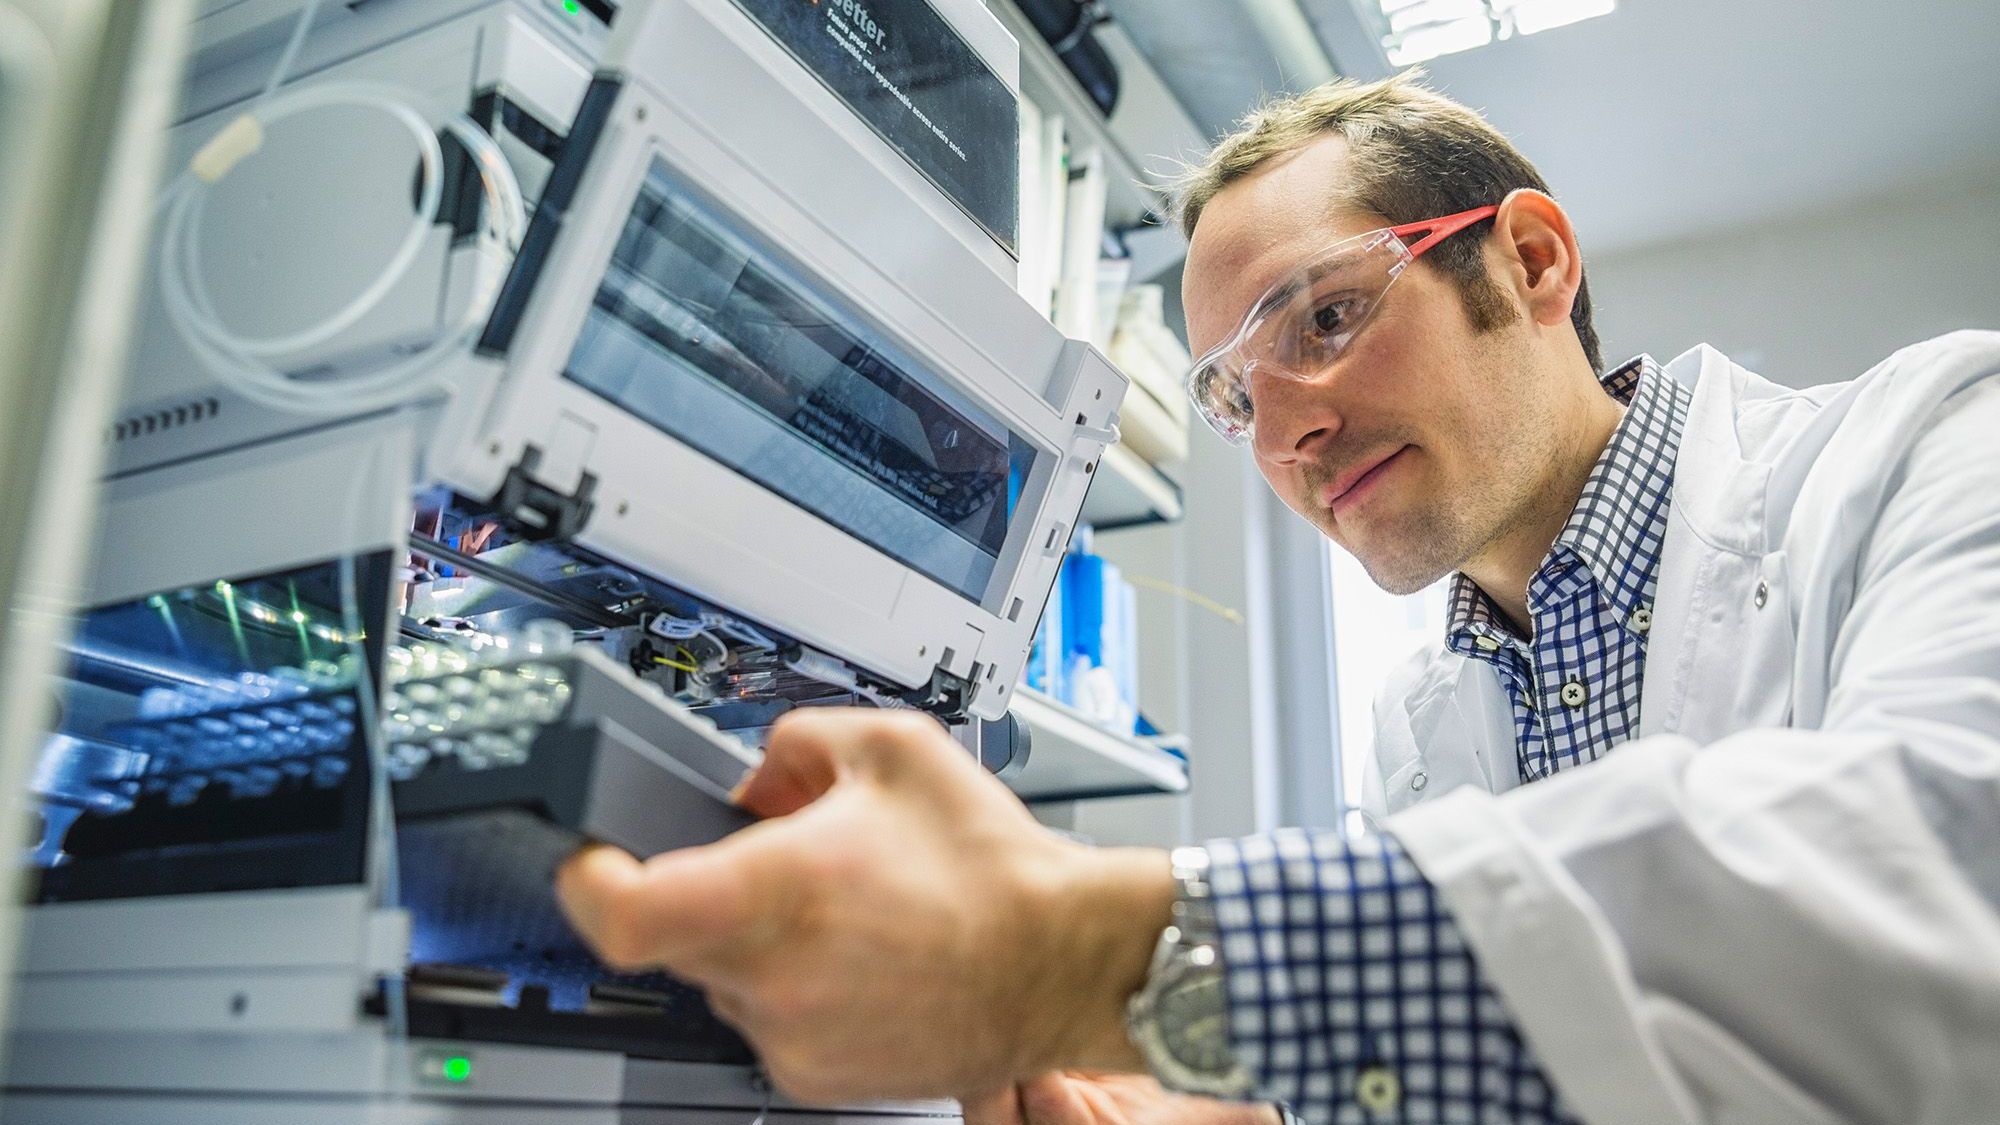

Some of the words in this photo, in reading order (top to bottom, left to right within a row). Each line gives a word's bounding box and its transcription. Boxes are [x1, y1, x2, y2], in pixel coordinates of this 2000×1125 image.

[827, 8, 849, 34] Future
[849, 31, 867, 51] proof
[863, 60, 876, 75] and
[875, 72, 912, 110] upgradeable
[912, 107, 932, 129] across
[932, 126, 949, 144] entire
[948, 141, 967, 162] series.
